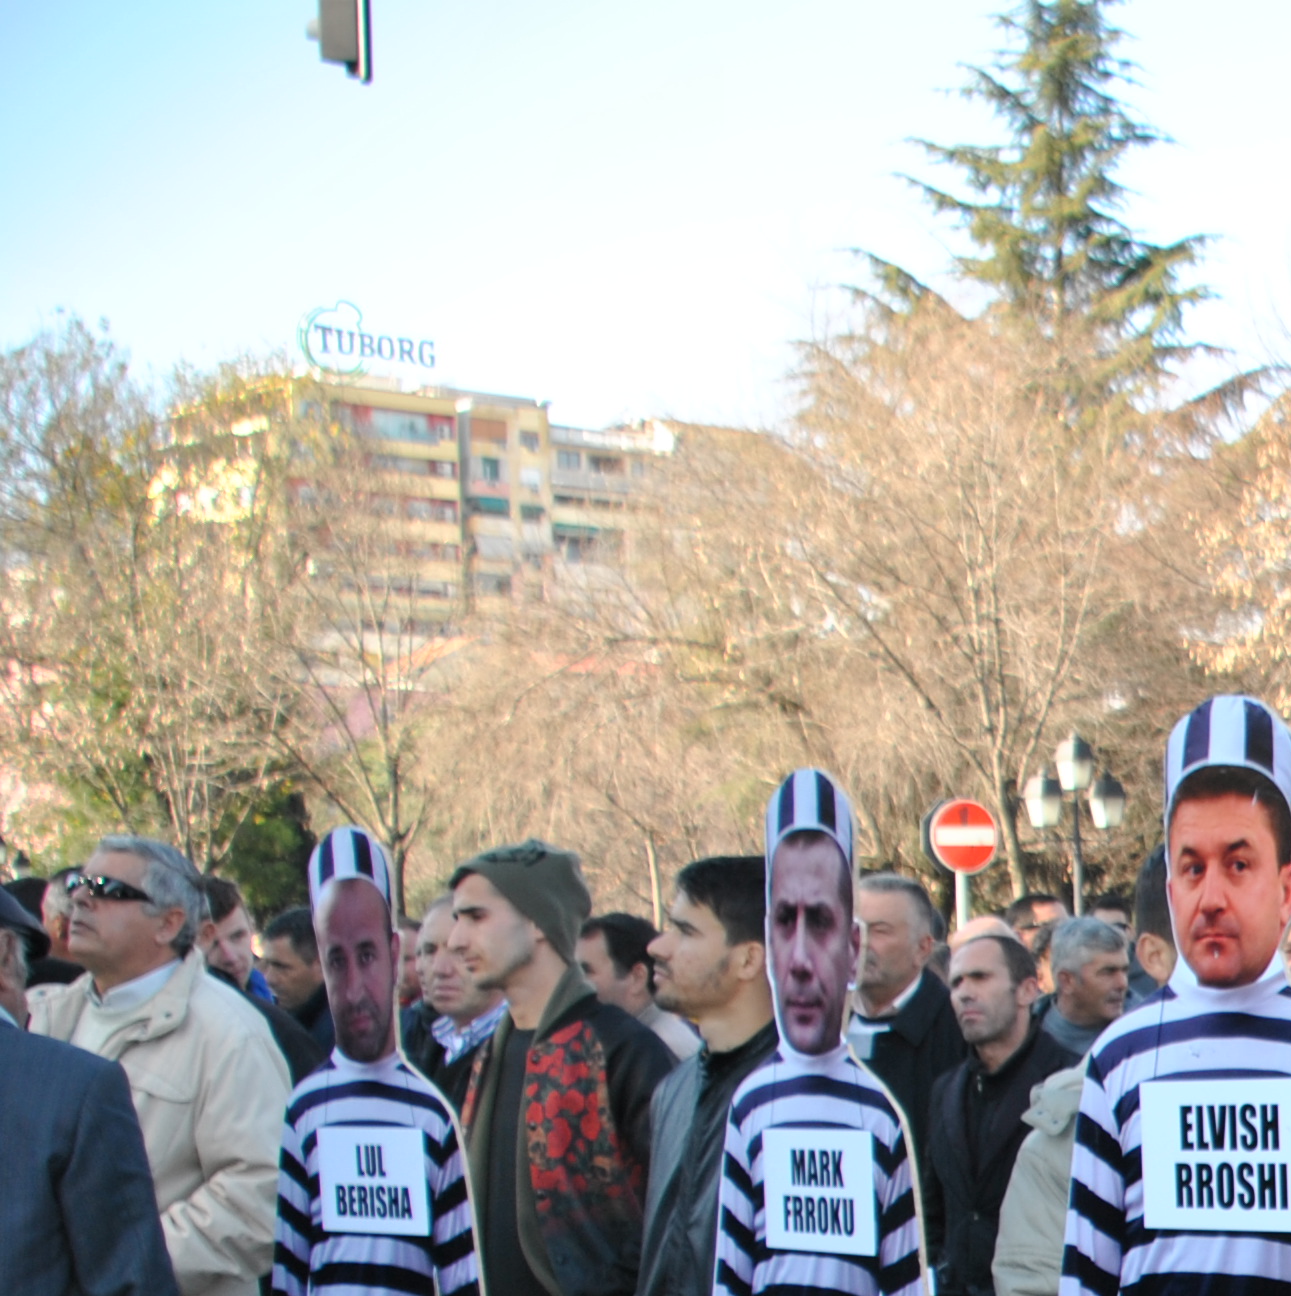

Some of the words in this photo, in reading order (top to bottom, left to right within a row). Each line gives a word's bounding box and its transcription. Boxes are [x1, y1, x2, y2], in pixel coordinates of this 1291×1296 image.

[314, 323, 436, 368] TUBORG
[1179, 1103, 1280, 1152] ELVISH
[355, 1144, 386, 1177] LUL
[790, 1149, 844, 1188] MARK
[335, 1184, 413, 1220] BERISHA
[1175, 1162, 1289, 1211] RROSHI
[783, 1195, 855, 1237] FRROKU
